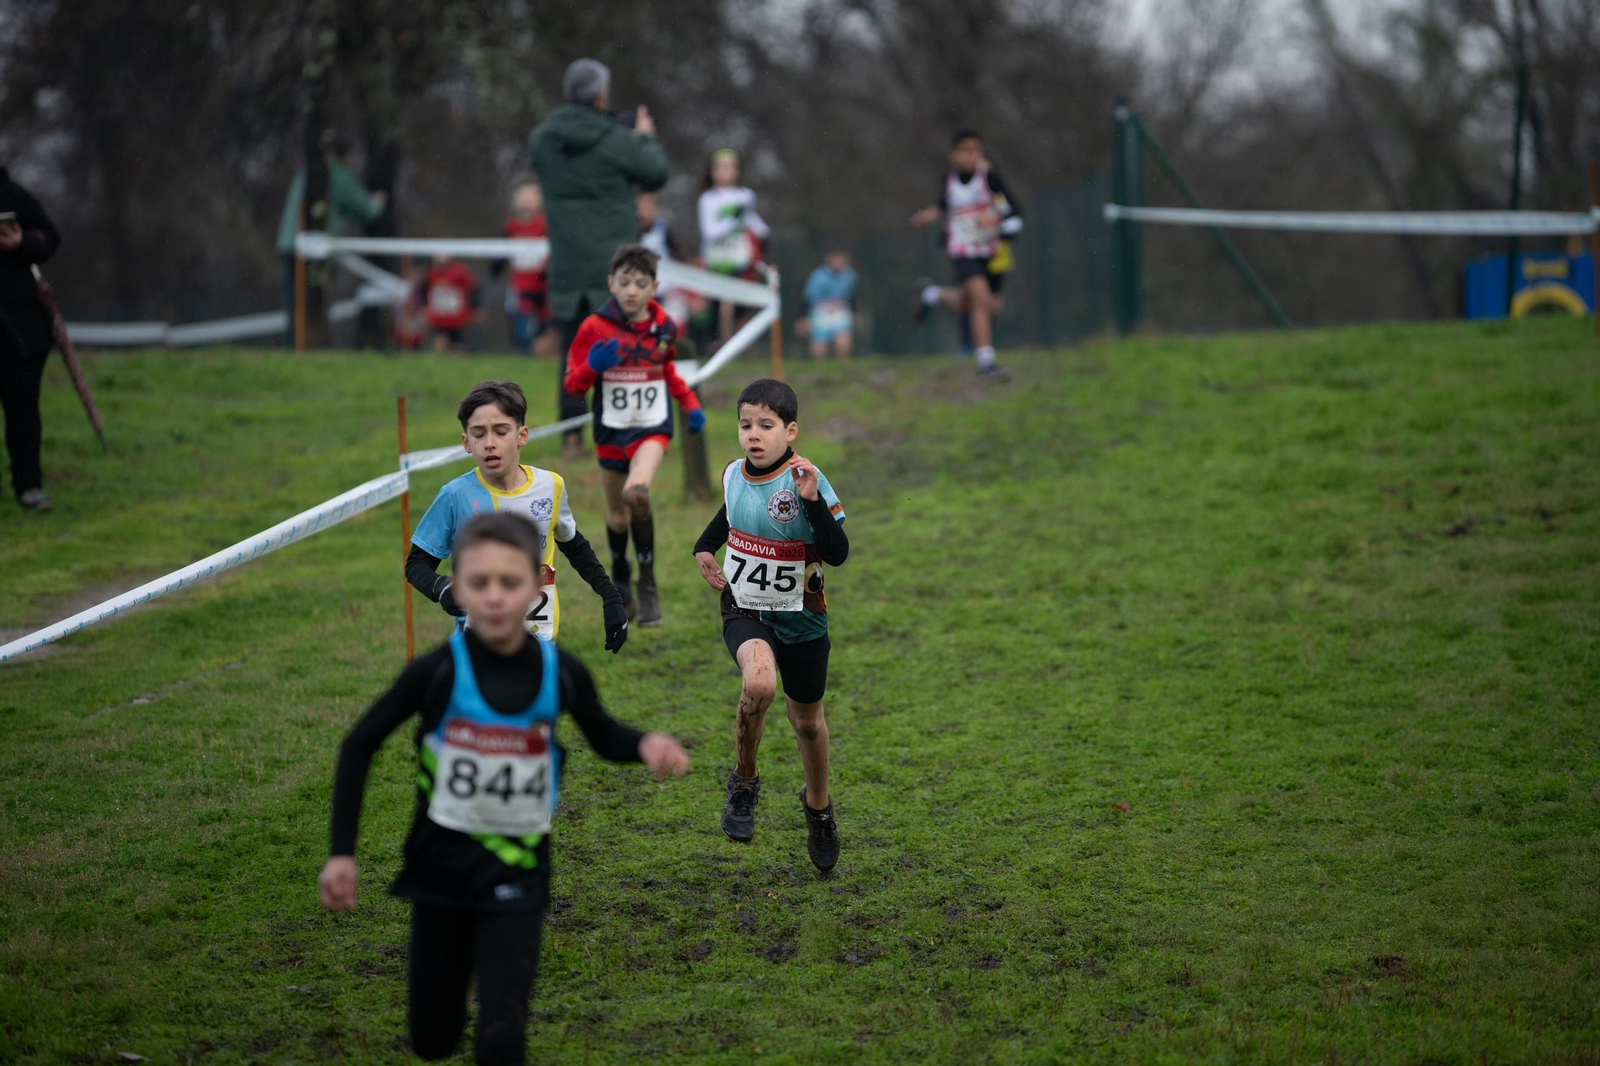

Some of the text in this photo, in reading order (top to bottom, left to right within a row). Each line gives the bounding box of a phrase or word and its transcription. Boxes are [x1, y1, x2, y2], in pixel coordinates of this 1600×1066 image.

[611, 386, 658, 410] 819
[728, 534, 805, 558] RIBADAVIA 2026
[730, 554, 797, 592] 745
[448, 757, 546, 804] 844
